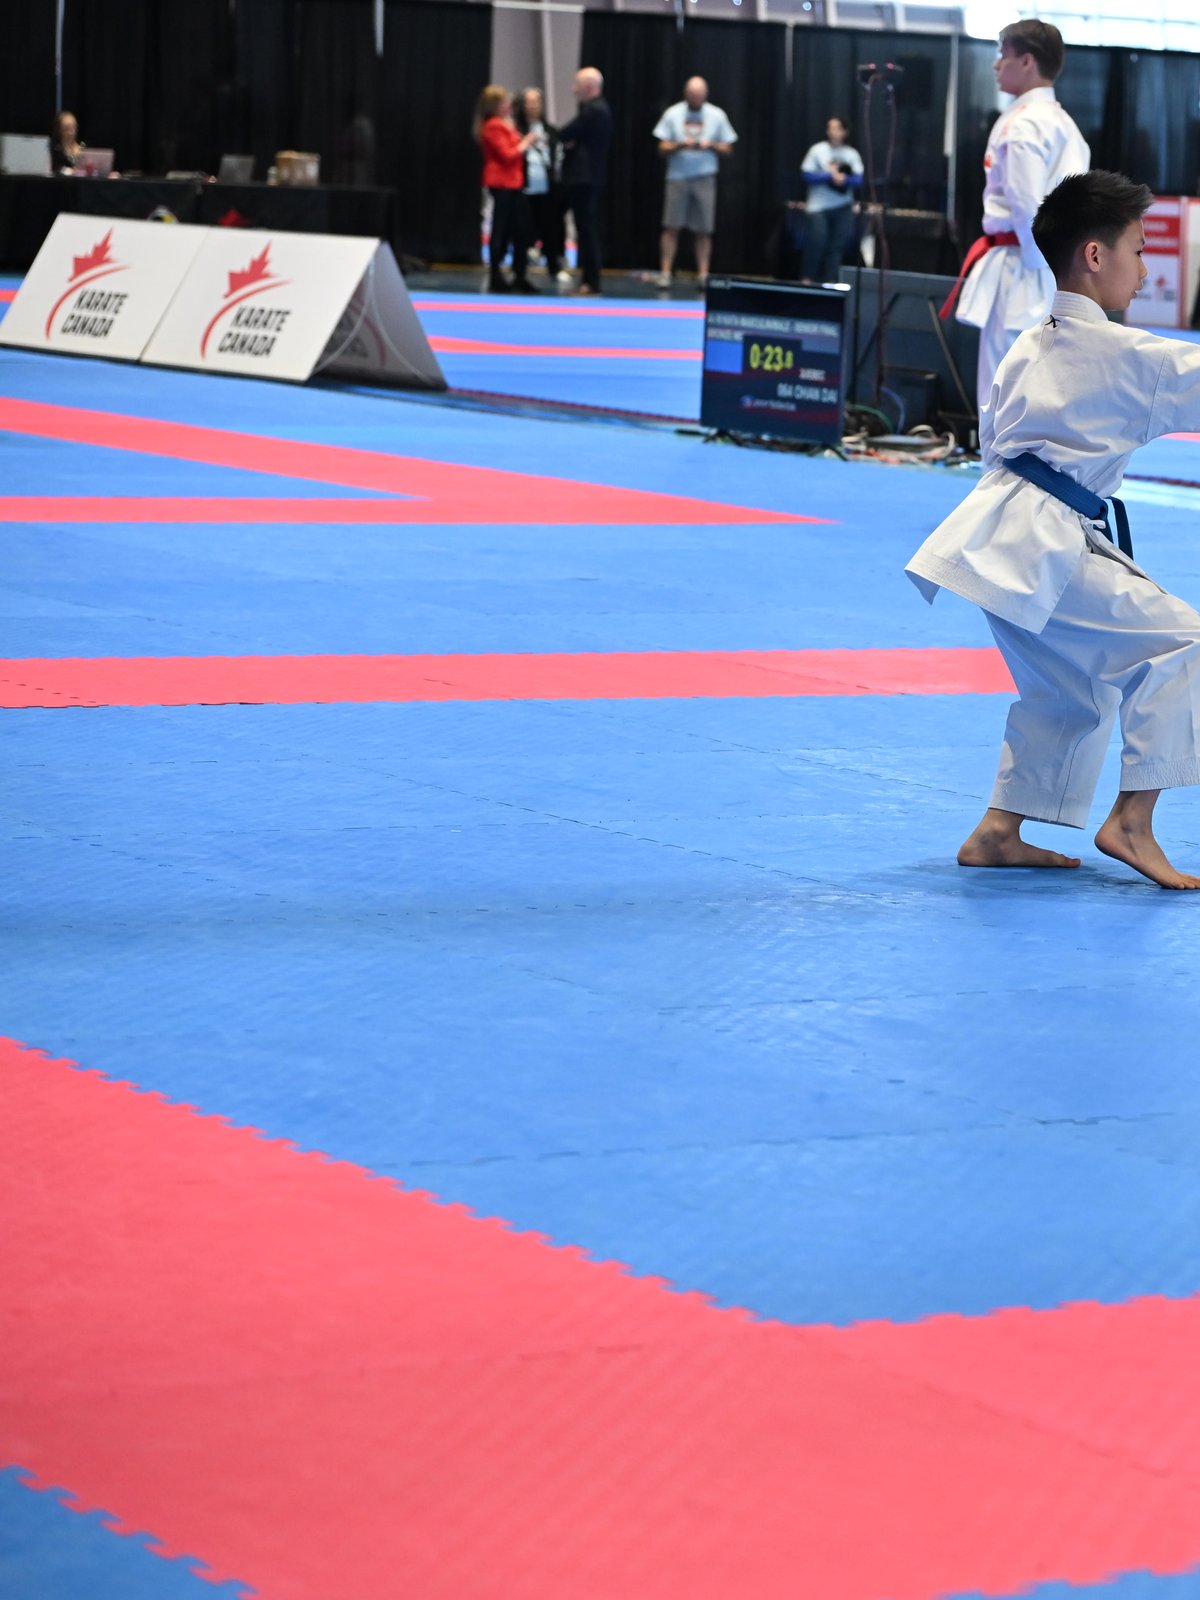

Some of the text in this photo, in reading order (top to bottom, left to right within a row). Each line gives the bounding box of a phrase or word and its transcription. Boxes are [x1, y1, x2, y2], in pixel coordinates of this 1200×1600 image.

[74, 289, 128, 313] KARATE
[61, 313, 114, 337] CANADA
[230, 306, 291, 332] KARATE
[217, 331, 277, 357] CANADA
